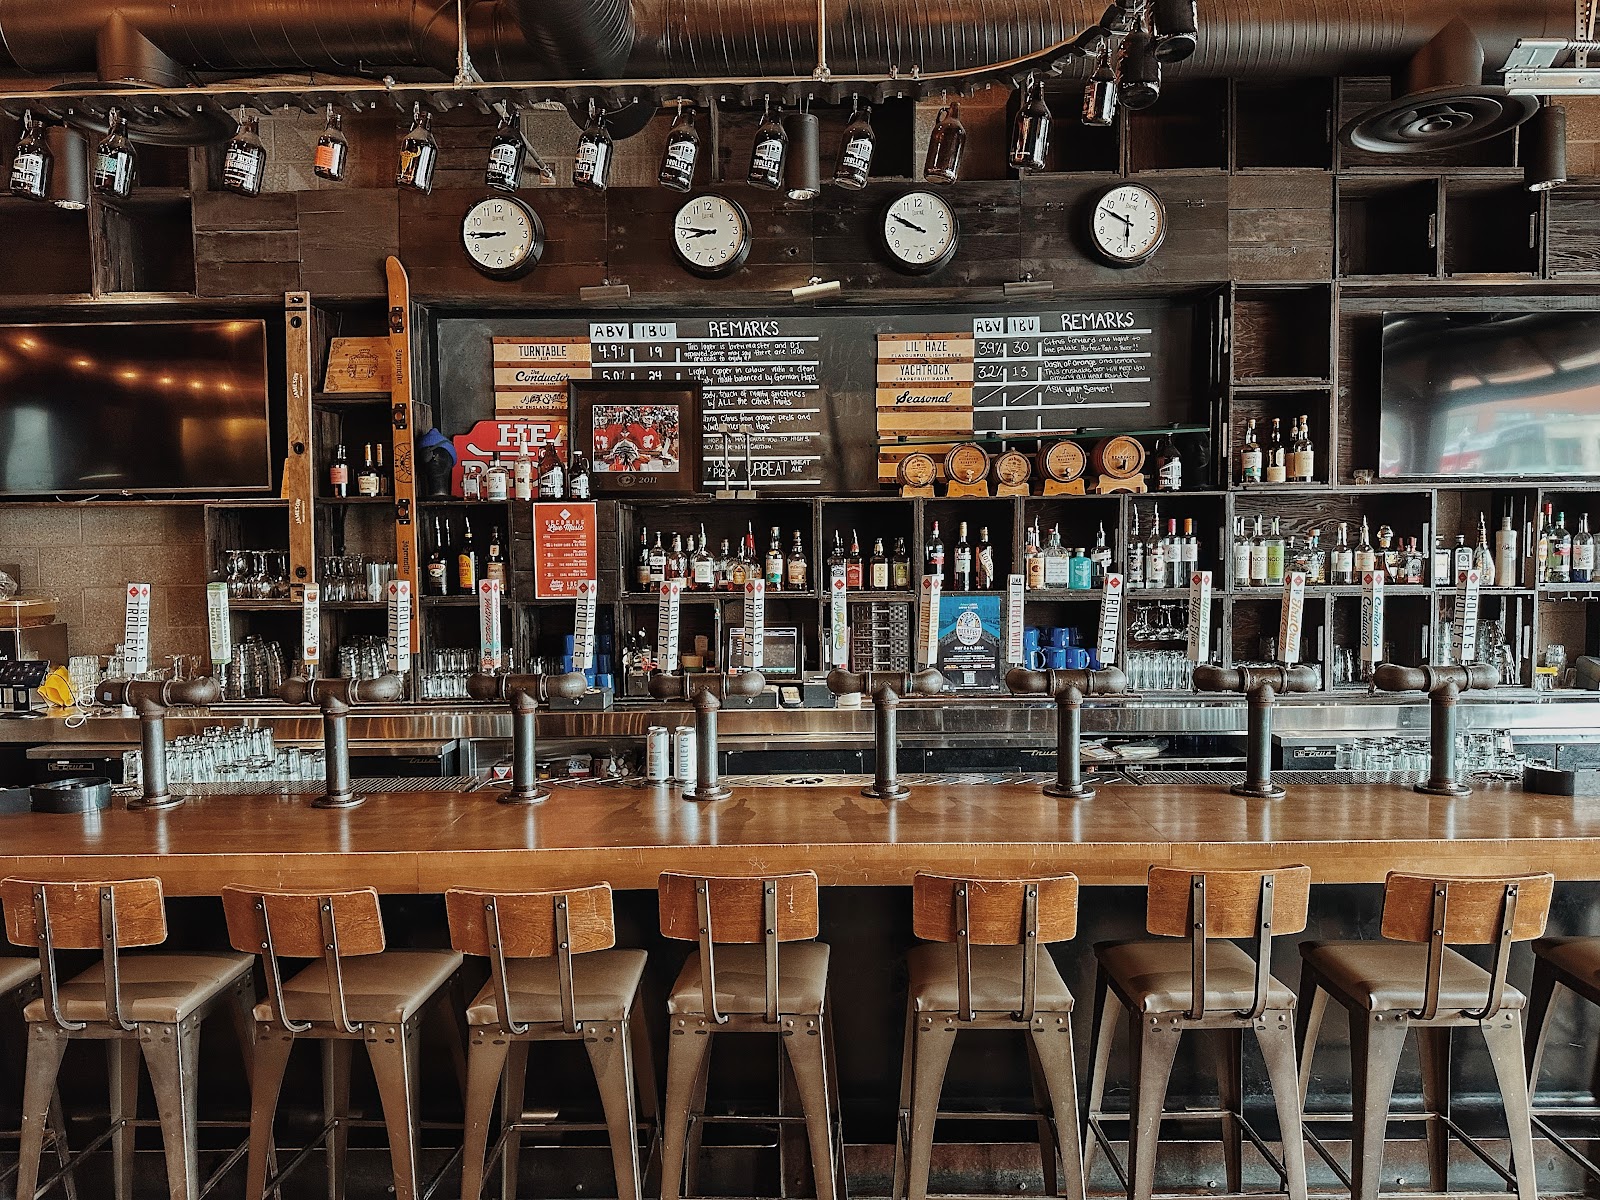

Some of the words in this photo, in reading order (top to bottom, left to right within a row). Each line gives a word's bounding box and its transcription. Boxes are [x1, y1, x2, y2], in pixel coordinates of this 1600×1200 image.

[484, 208, 490, 216] 11
[494, 204, 503, 214] 12
[473, 218, 482, 226] 10
[518, 216, 524, 226] 2
[522, 230, 528, 239] 3
[474, 244, 480, 252] 8
[519, 244, 524, 252] 4
[484, 254, 490, 262] 7
[496, 256, 502, 265] 6
[509, 252, 516, 262] 5
[976, 320, 1001, 333] ABV
[1013, 320, 1034, 332] IBU
[1060, 312, 1136, 331] REMARKS
[594, 325, 624, 338] ABV
[642, 325, 667, 337] IBU
[708, 320, 780, 338] REMARKS
[1067, 336, 1096, 344] forward
[518, 345, 567, 356] TURNTABLE
[598, 344, 625, 358] 4.9%
[648, 346, 663, 358] 19
[685, 342, 699, 351] This
[700, 342, 716, 353] lager
[774, 342, 787, 350] and
[790, 342, 800, 350] DJ
[925, 341, 948, 352] HAZE
[1012, 341, 1030, 354] 30
[1044, 346, 1056, 354] the
[741, 350, 752, 358] say
[753, 348, 772, 356] there
[744, 365, 766, 375] colour
[796, 364, 815, 373] clean
[900, 364, 950, 376] YACHTROCK
[1044, 360, 1064, 369] Dash
[1064, 359, 1072, 368] of
[515, 370, 570, 382] Conductor
[648, 370, 662, 380] 24
[734, 372, 763, 384] balanced
[764, 373, 774, 384] by
[774, 372, 801, 382] German
[1012, 366, 1029, 378] 13
[1044, 368, 1062, 376] This
[720, 390, 738, 399] touch
[740, 389, 748, 398] of
[1082, 384, 1115, 394] Server!
[707, 399, 716, 410] by
[718, 398, 736, 408] ALL
[736, 397, 748, 406] the
[896, 390, 953, 405] Seasonal
[740, 412, 754, 422] from
[754, 414, 776, 425] orange
[797, 412, 812, 421] and
[638, 476, 659, 484] 2011
[1190, 596, 1201, 623] High
[1201, 597, 1209, 623] High
[1454, 588, 1466, 639] TROLLEY
[1464, 588, 1478, 639] TROLLEY
[575, 598, 590, 648] TROLLEY
[744, 597, 754, 648] TROLLEY
[754, 597, 764, 646] TROLLEY
[1103, 592, 1120, 642] TROLLEY
[1362, 596, 1372, 648] Conductor
[1373, 596, 1382, 648] Conductor
[126, 601, 140, 652] TROLLEY
[388, 600, 398, 652] TROLLEY
[399, 598, 409, 649] TROLLEY
[658, 600, 670, 649] TROLLEY
[669, 599, 678, 649] TROLLEY
[920, 601, 930, 650] TURNTABLE
[1190, 625, 1200, 647] Five
[1200, 626, 1208, 648] Five
[1288, 622, 1299, 653] Crush
[680, 744, 688, 776] TROLLEY
